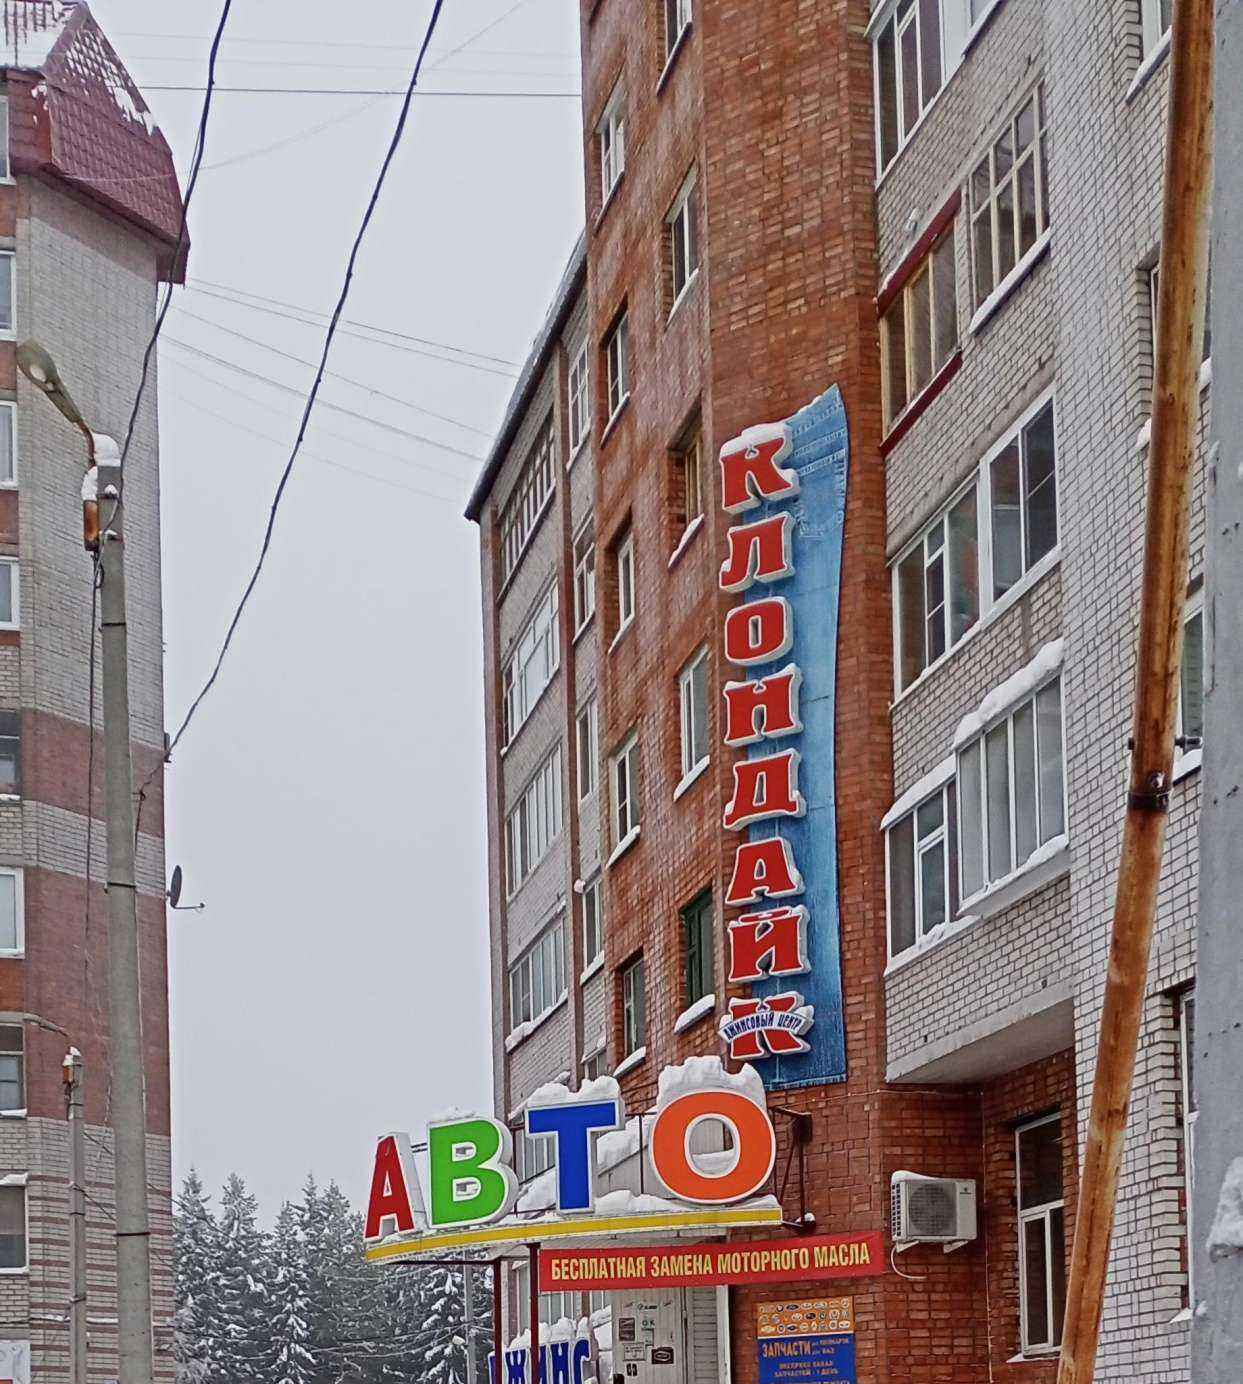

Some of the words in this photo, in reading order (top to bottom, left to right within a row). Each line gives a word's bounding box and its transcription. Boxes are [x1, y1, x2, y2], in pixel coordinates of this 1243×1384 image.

[719, 434, 806, 1058] КЛОНДАЙК
[723, 1012, 774, 1040] ДЖИНСОВЫЙ
[364, 1090, 777, 1243] АВТО
[551, 1257, 646, 1281] БЕСПЛАТНАЯ
[650, 1254, 714, 1278] ЗАМЕНА
[717, 1247, 810, 1275] МОТОРНОГО
[814, 1242, 871, 1268] МАСЛА
[762, 1341, 811, 1357] ЗАПЧАСТИ
